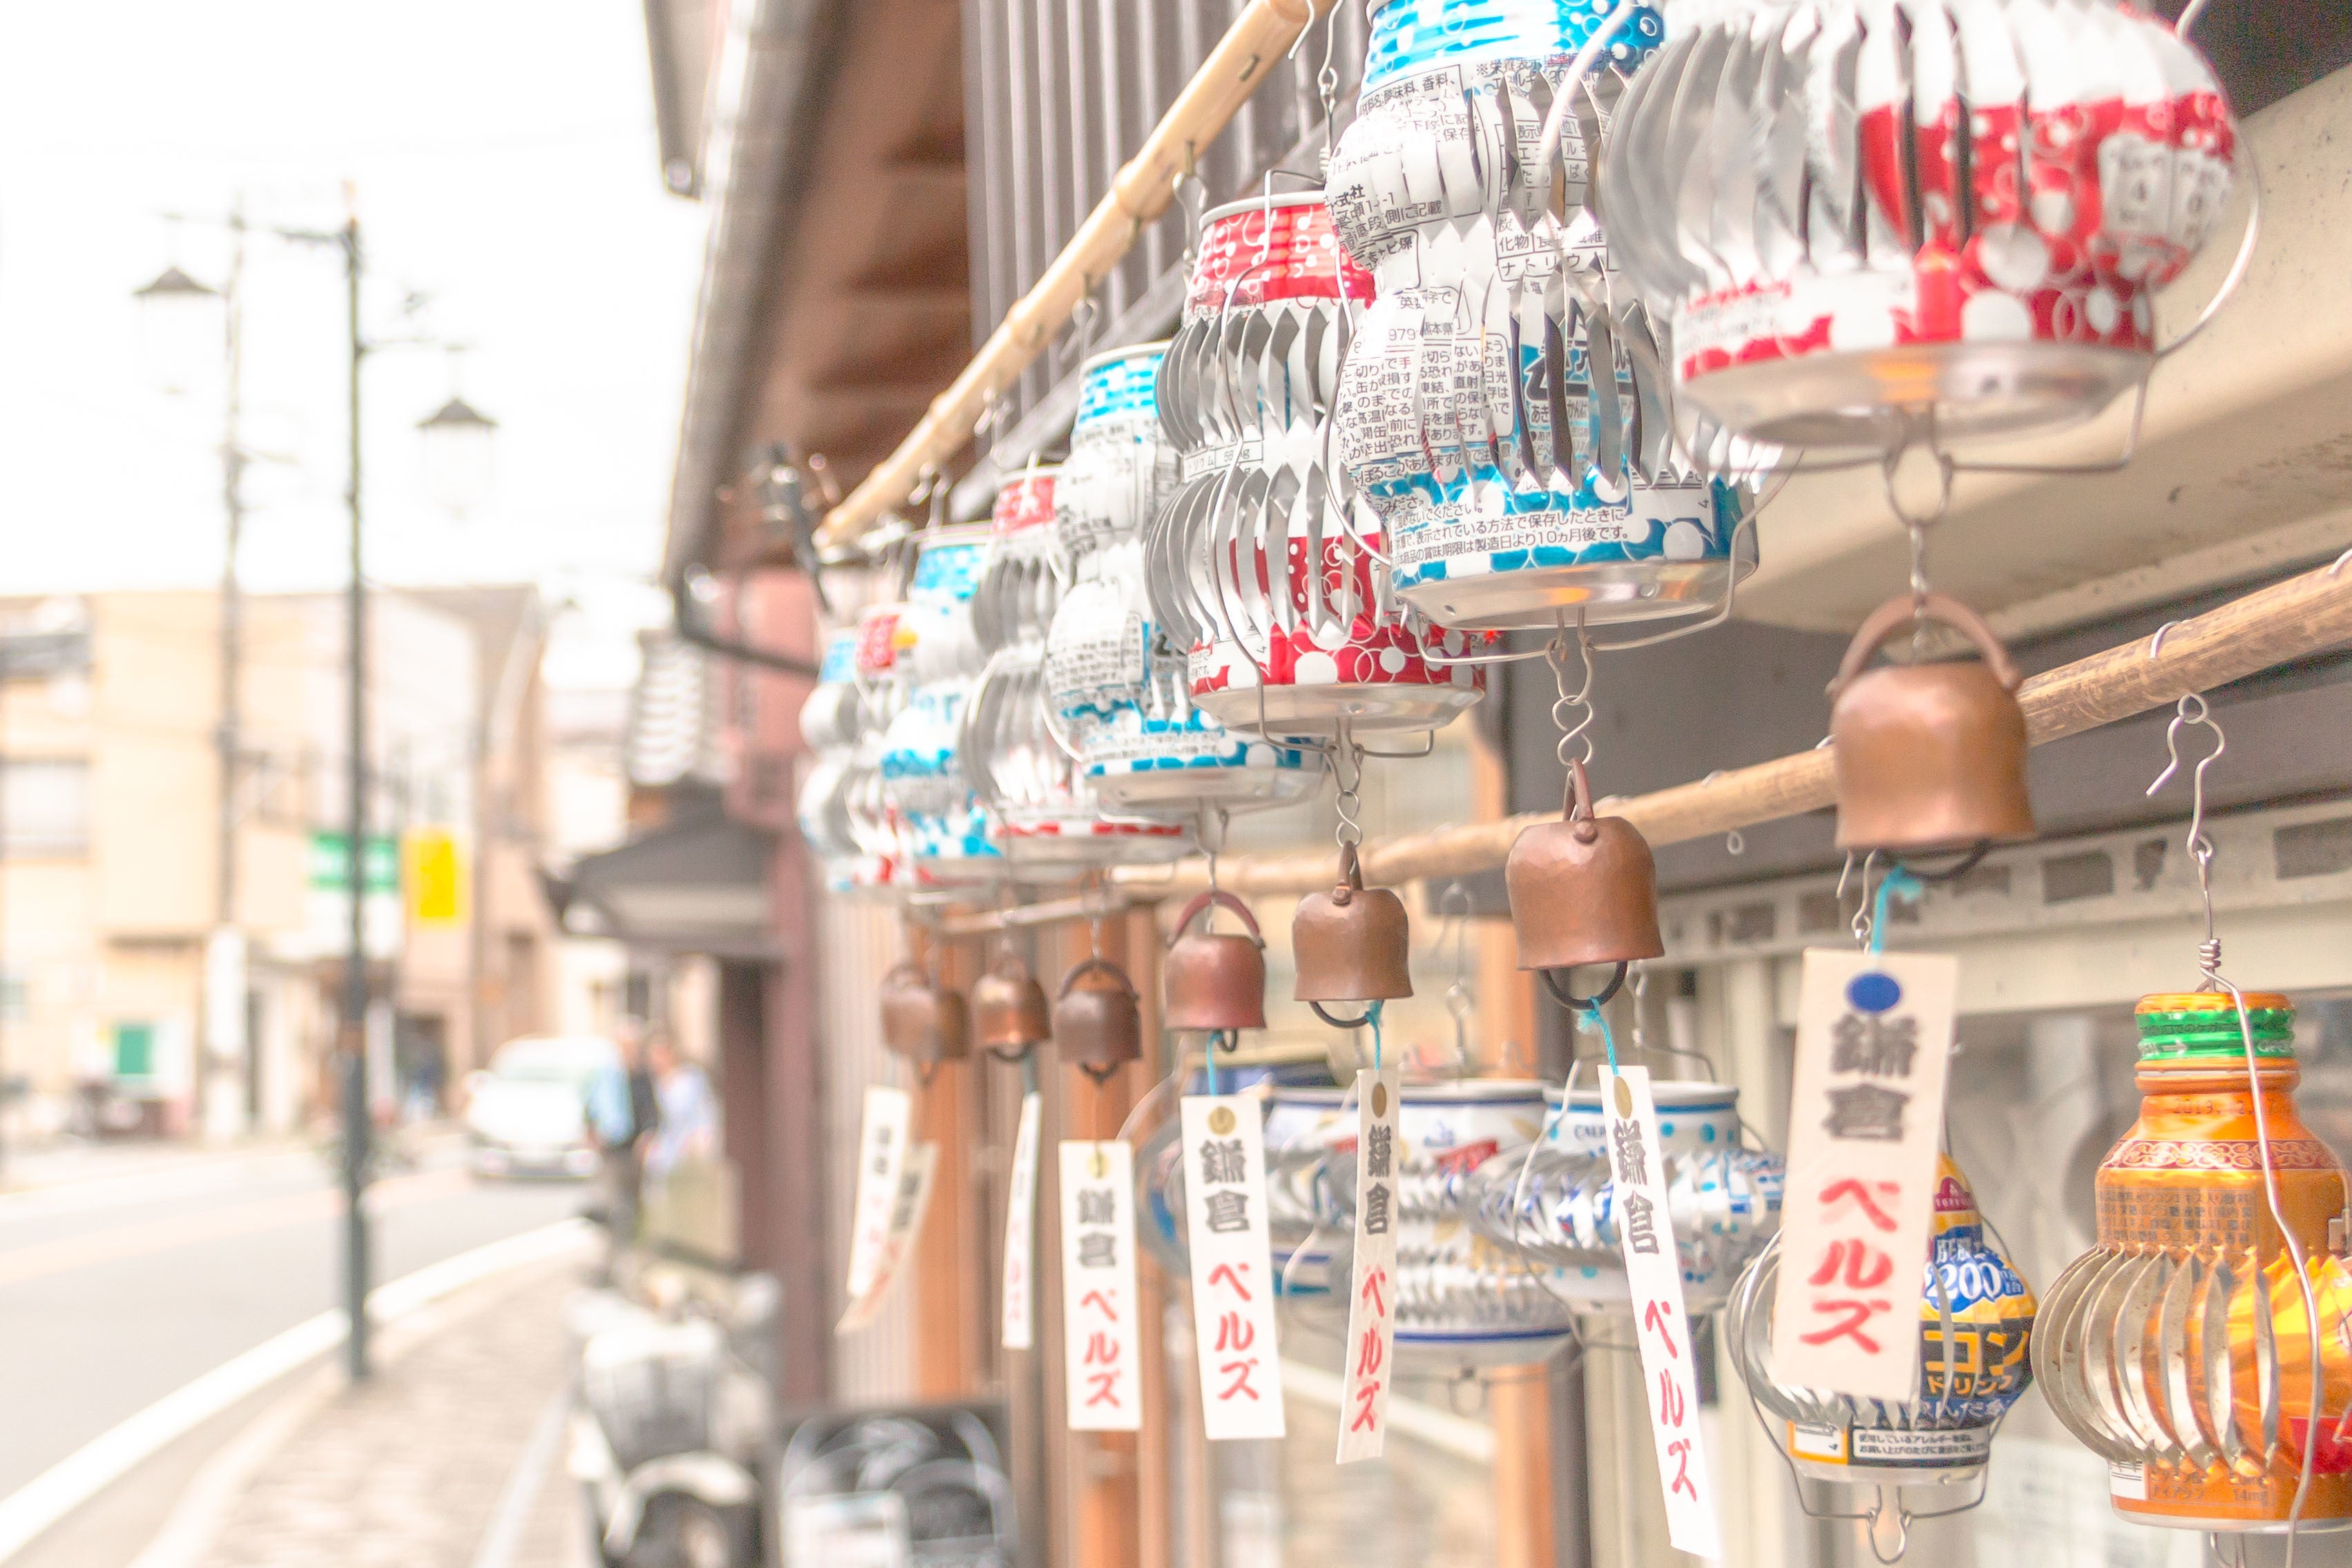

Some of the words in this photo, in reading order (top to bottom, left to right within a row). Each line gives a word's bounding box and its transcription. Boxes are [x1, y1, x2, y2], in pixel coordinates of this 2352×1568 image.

[1080, 1288, 1122, 1410] ベルズ
[1207, 1261, 1260, 1402] ベルズ
[1350, 1264, 1387, 1433] ベルズ
[1799, 1176, 1902, 1356] ベルズ
[1645, 1298, 1698, 1502] ベルズ
